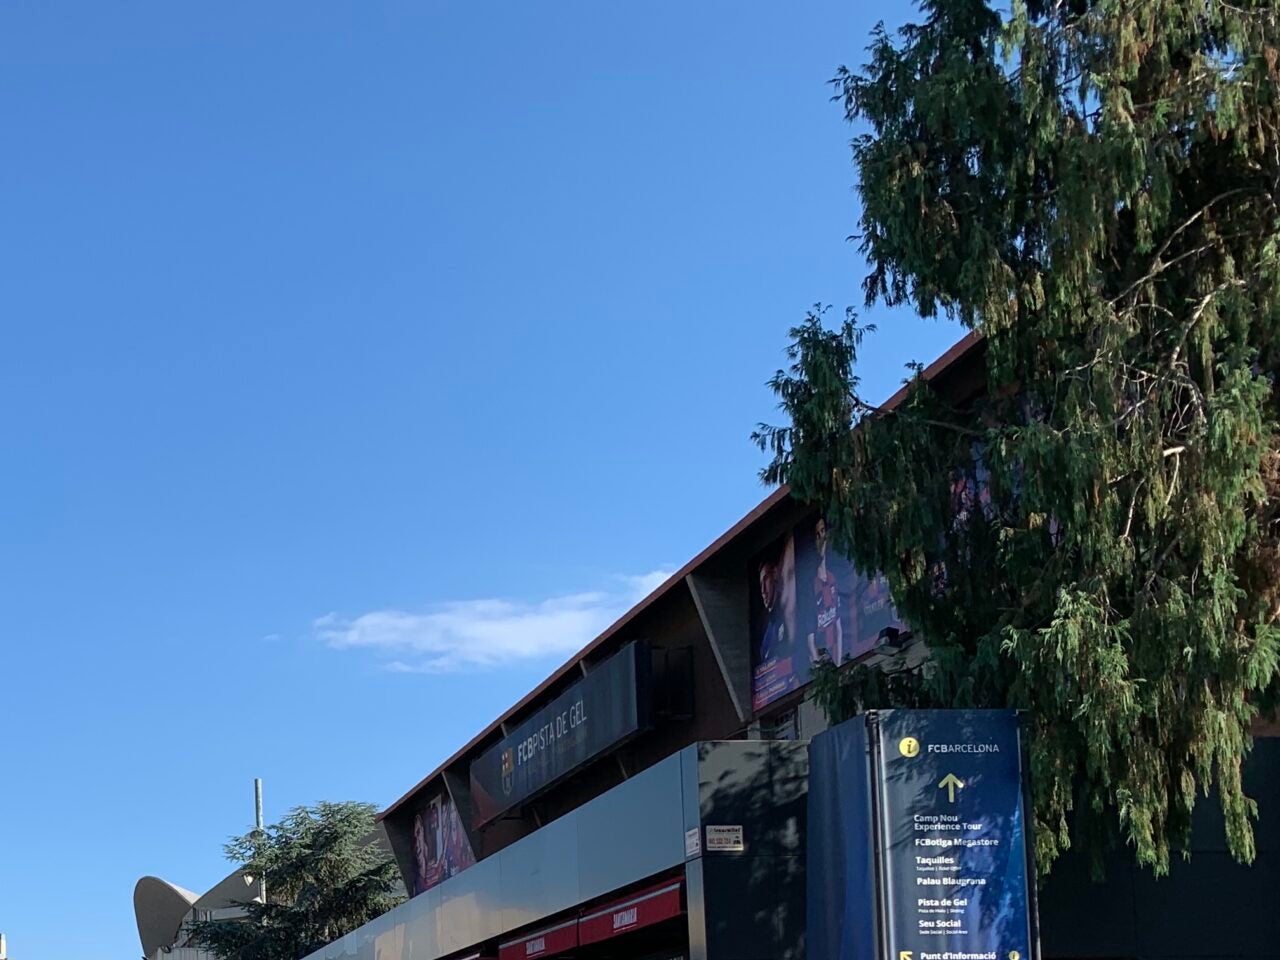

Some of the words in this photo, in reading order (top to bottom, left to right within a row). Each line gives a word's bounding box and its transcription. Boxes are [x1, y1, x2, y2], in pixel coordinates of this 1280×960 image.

[556, 711, 569, 740] DE
[569, 699, 588, 728] GEL
[927, 743, 1000, 753] FCBARCELONA
[913, 814, 939, 824] Camp
[940, 814, 959, 822] Nou
[914, 822, 961, 832] Experience
[915, 838, 953, 848] FCBotiga
[954, 838, 1000, 848] Megastore
[915, 856, 955, 865] Taquilles
[916, 877, 941, 885] Palau
[942, 877, 987, 887] Blaugrana
[918, 898, 939, 906] Pista
[940, 898, 952, 906] de
[953, 898, 968, 906] Gel
[918, 919, 935, 928] Seu
[936, 919, 962, 928] Social
[920, 952, 942, 960] Punt
[942, 951, 997, 960] d'Informació
